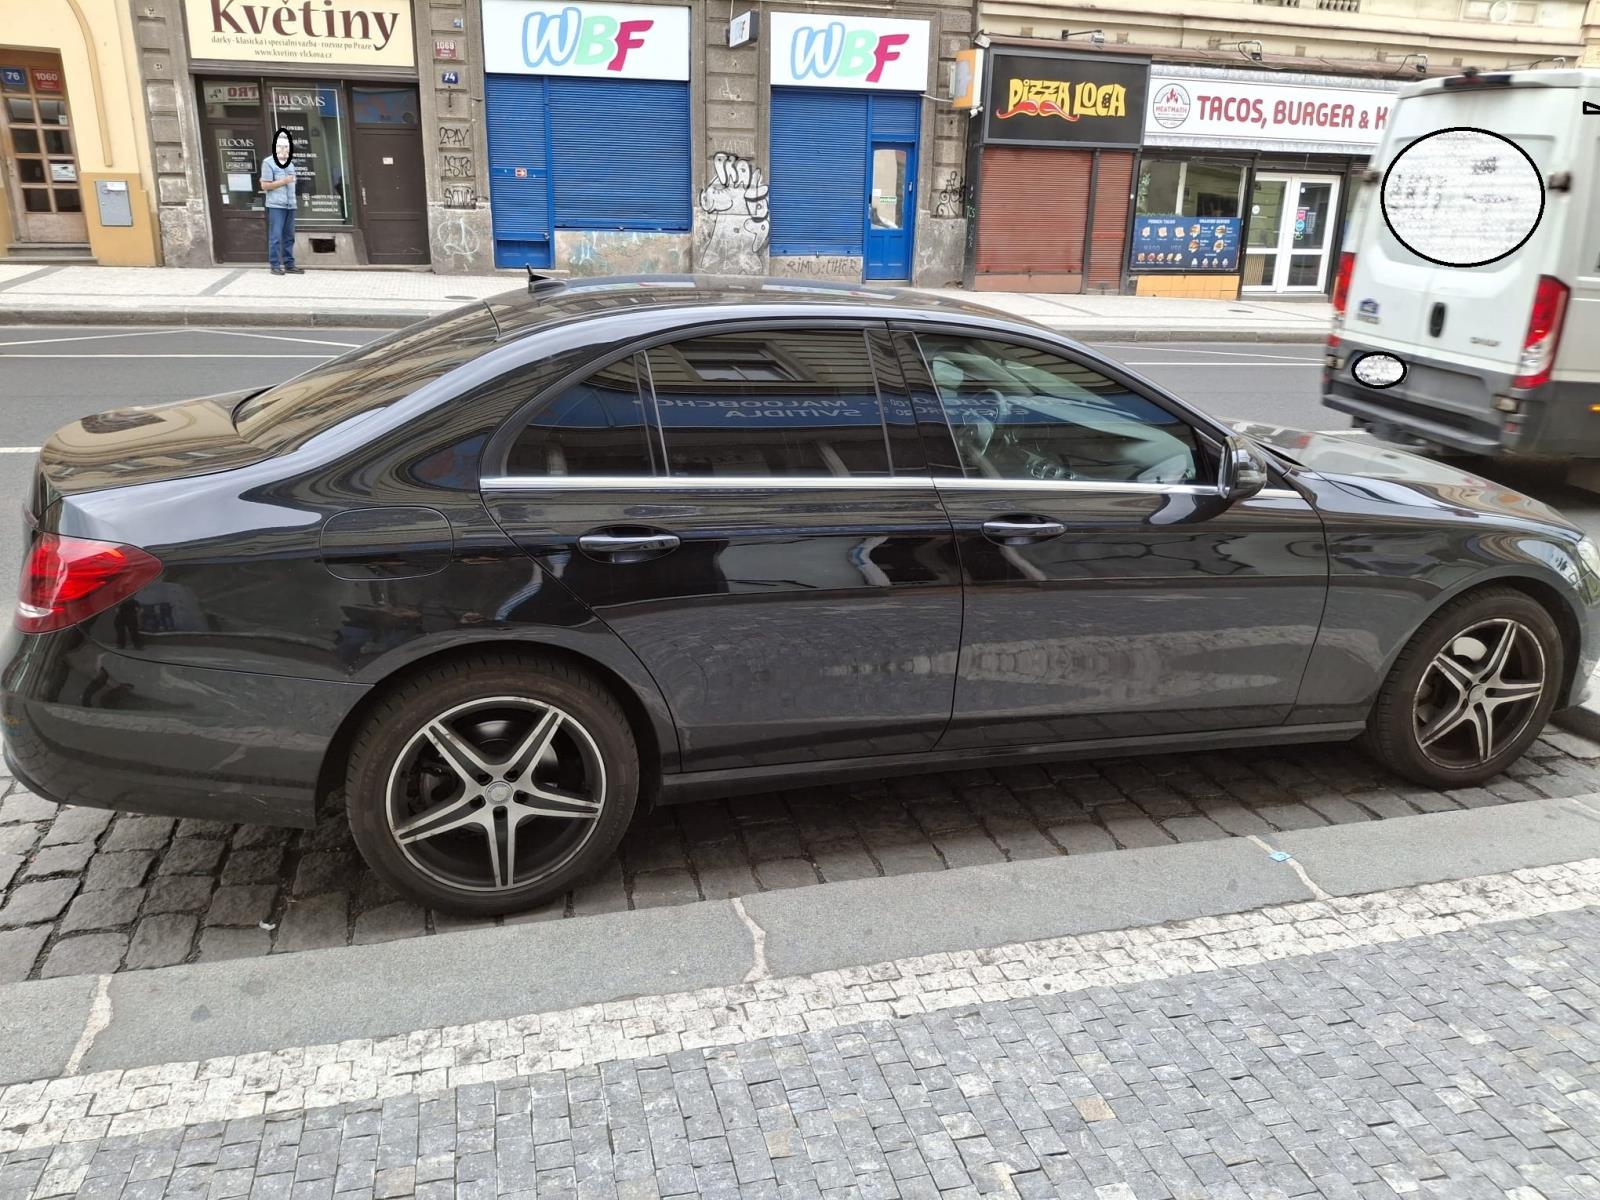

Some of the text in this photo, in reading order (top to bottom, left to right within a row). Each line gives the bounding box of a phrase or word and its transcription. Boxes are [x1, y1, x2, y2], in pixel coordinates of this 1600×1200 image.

[210, 0, 400, 51] Květiny
[522, 7, 654, 72] WBF
[790, 22, 910, 83] WBF
[6, 72, 20, 80] 76
[35, 72, 58, 81] 1060
[278, 95, 326, 107] BLOOMS
[1073, 81, 1126, 117] LOCA
[1197, 95, 1267, 129] TACOS,
[1273, 100, 1355, 128] BURGER
[1358, 110, 1370, 129] &
